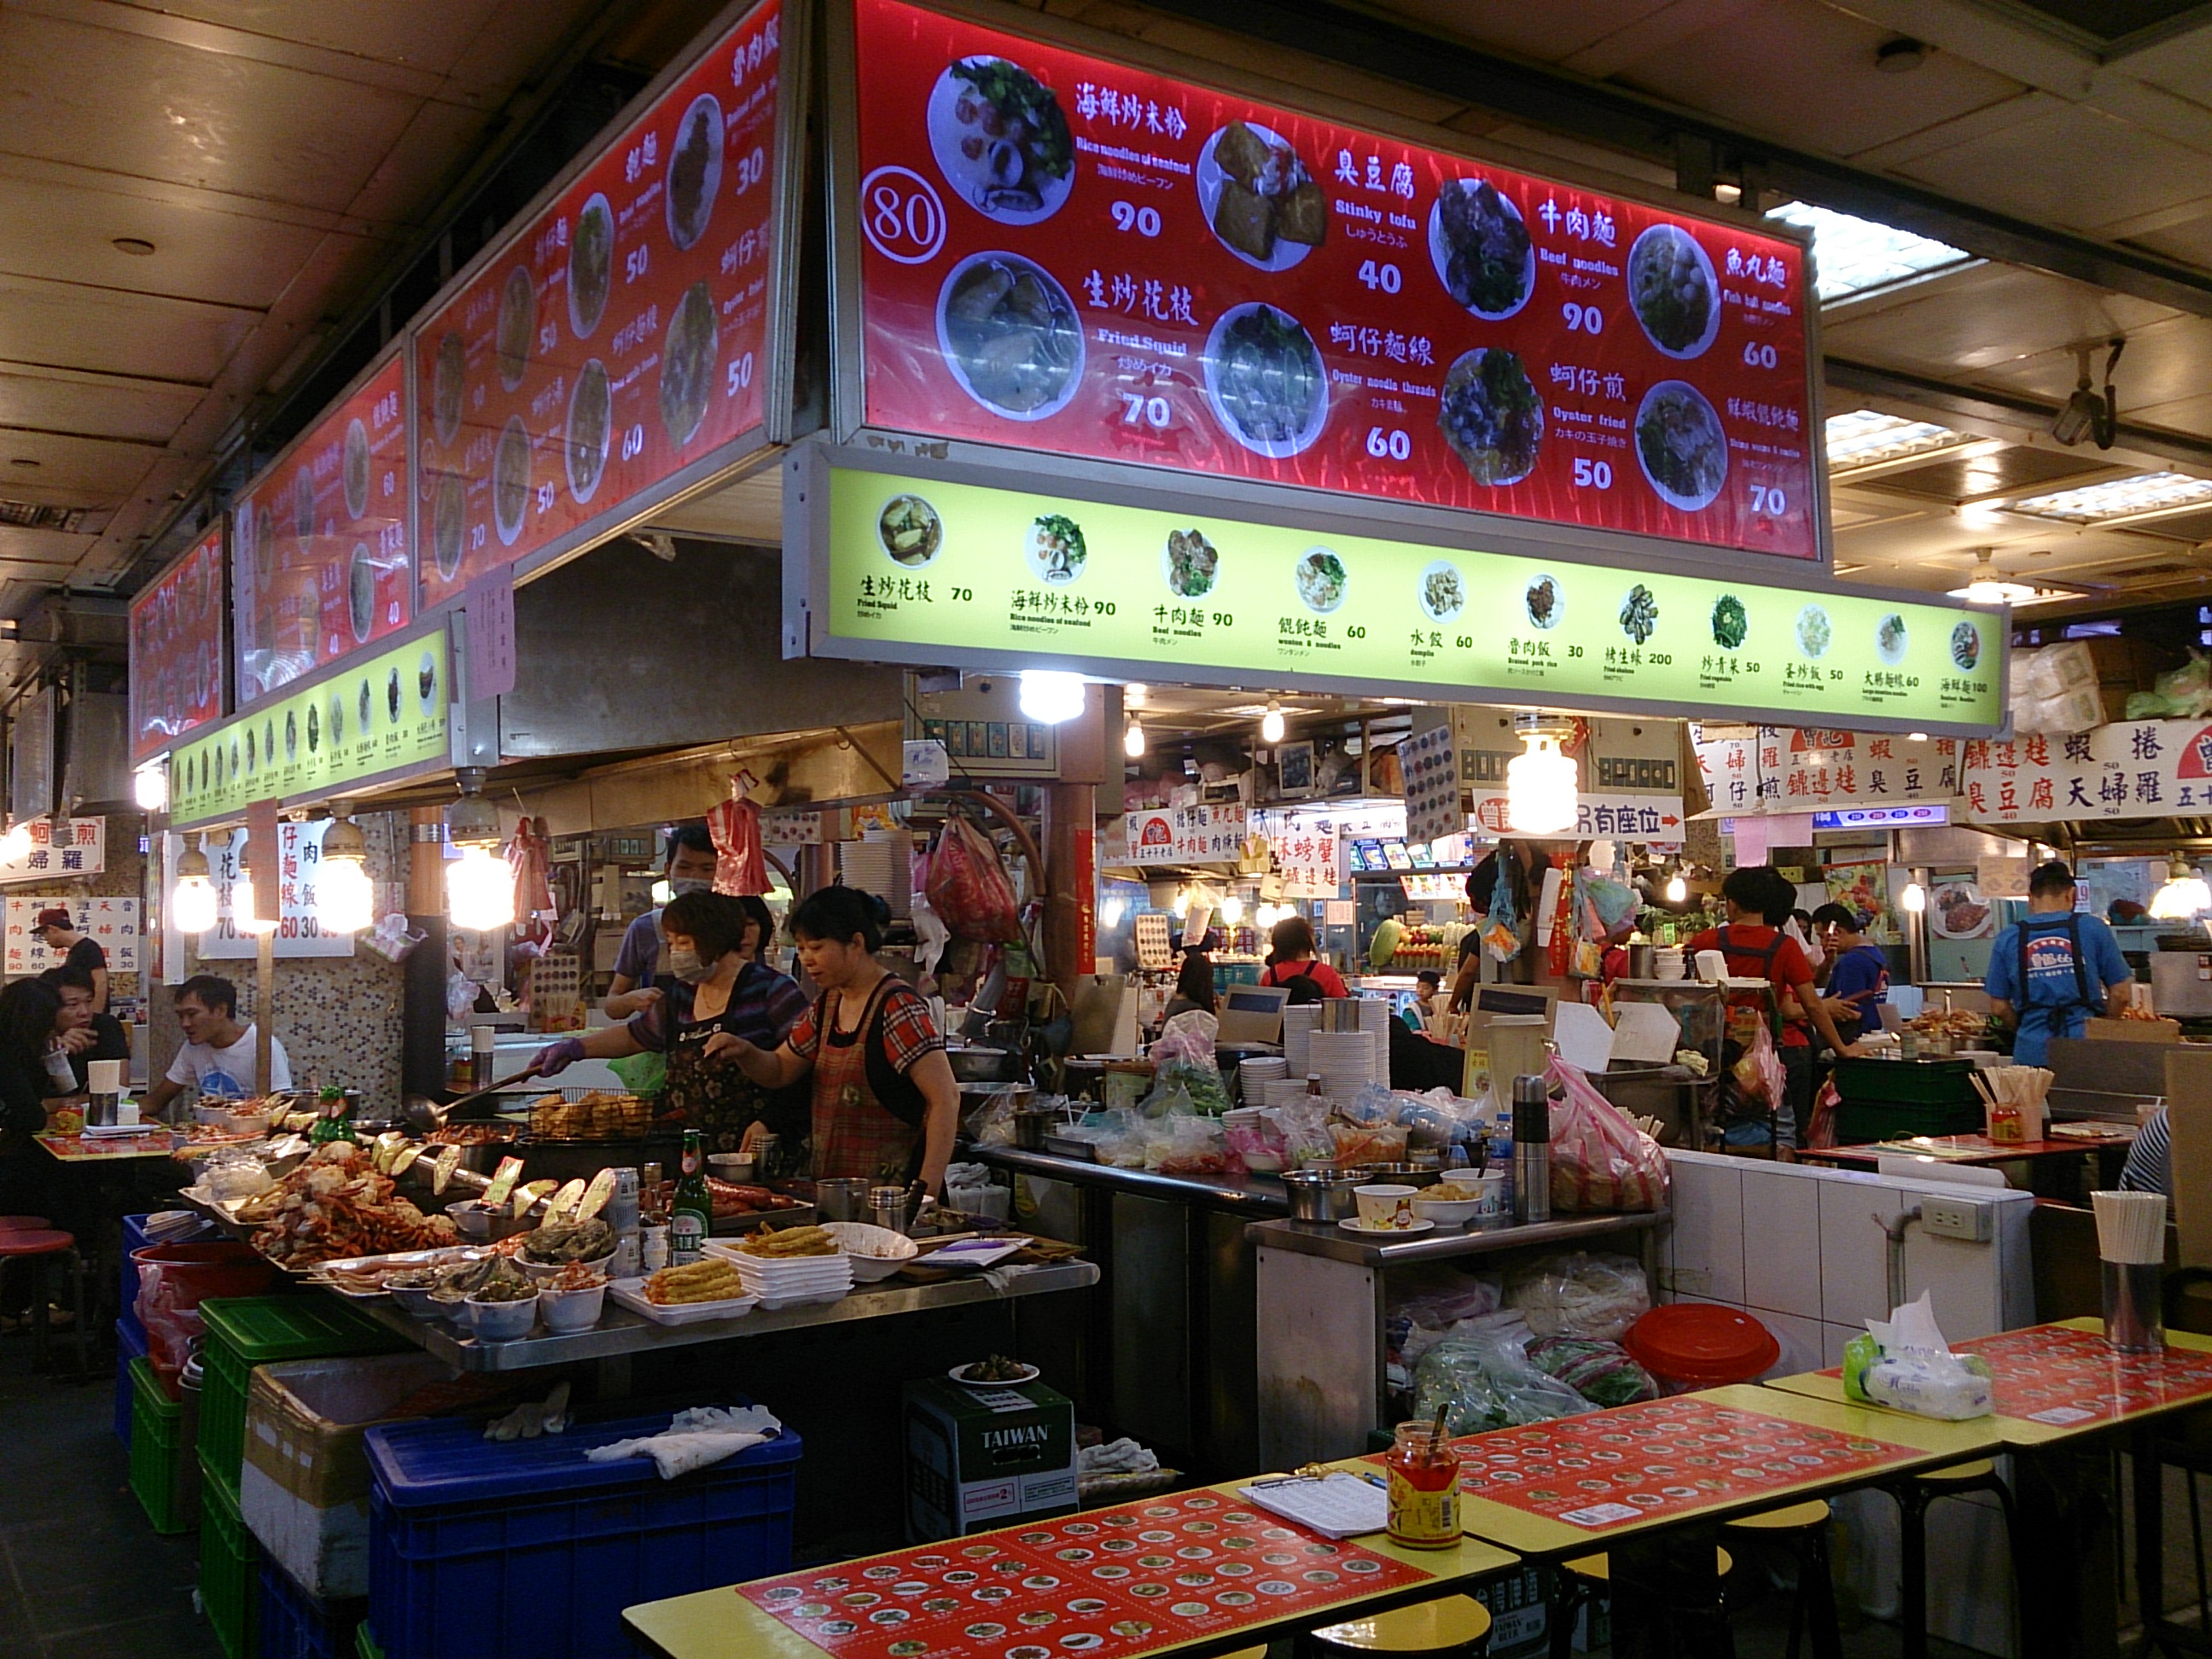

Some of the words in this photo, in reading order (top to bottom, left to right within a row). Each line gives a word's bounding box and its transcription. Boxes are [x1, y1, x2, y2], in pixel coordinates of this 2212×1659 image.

[1076, 82, 1187, 140] 海鮮炒米粉
[737, 147, 763, 195] 30
[1335, 148, 1414, 199] 臭豆腐
[873, 186, 936, 245] 80
[1111, 201, 1161, 236] 90
[1336, 199, 1382, 224] Stinky
[1389, 212, 1417, 230] tofu
[1539, 199, 1615, 247] 牛肉麵
[1346, 224, 1407, 248] しゅうとうふ
[626, 243, 648, 283] 50
[1540, 247, 1566, 265] Beef
[1574, 259, 1618, 276] noodles
[1726, 247, 1785, 288] 魚丸麵
[1359, 259, 1401, 294] 40
[1083, 270, 1199, 325] 生炒花枝
[1563, 303, 1602, 335] 90
[540, 321, 556, 354] 50
[1097, 328, 1138, 345] Fried
[1143, 336, 1187, 355] Squid
[1330, 321, 1435, 366] 蚵仔麵線
[1117, 357, 1172, 375] 炒めイカ
[1744, 342, 1777, 369] 60
[727, 352, 752, 397] 50
[1333, 369, 1362, 385] Oyster
[1367, 377, 1398, 391] noodle
[1402, 381, 1436, 398] threads
[1551, 363, 1626, 402] 蚵仔煎
[1123, 393, 1171, 426] 70
[1553, 406, 1592, 423] Oyster
[1599, 414, 1626, 429] fried
[622, 423, 643, 461] 60
[1367, 427, 1411, 460] 60
[1575, 457, 1611, 489] 50
[538, 480, 554, 514] 50
[1750, 485, 1785, 515] 70
[471, 523, 484, 550] 70
[861, 575, 934, 602] 生炒花枝
[952, 587, 972, 601] 70
[1011, 590, 1089, 615] 海鮮炒米粉
[1094, 602, 1115, 615] 90
[388, 600, 399, 626] 40
[1153, 603, 1204, 627] 牛肉麵
[1213, 613, 1232, 626] 90
[1278, 617, 1326, 638] 餛飩麵
[1348, 626, 1365, 638] 60
[1411, 629, 1443, 648] 水餃
[1456, 636, 1472, 648] 60
[1568, 646, 1583, 658] 30
[1650, 654, 1672, 666] 200
[1702, 655, 1739, 674] 炒青菜
[1746, 662, 1760, 672] 50
[1831, 670, 1842, 680] 50
[1906, 676, 1919, 687] 60
[1973, 683, 1988, 693] 100
[2065, 726, 2163, 764] 蝦捲
[2103, 761, 2119, 770] 50
[1968, 778, 2055, 814] 臭豆腐
[2068, 771, 2163, 807] 天婦羅
[2001, 812, 2017, 820] 40
[30, 822, 96, 846] 蚵煎
[218, 917, 235, 939] 70
[281, 917, 298, 938] 60
[301, 917, 318, 938] 30
[981, 1423, 1049, 1448] TAIWAN
